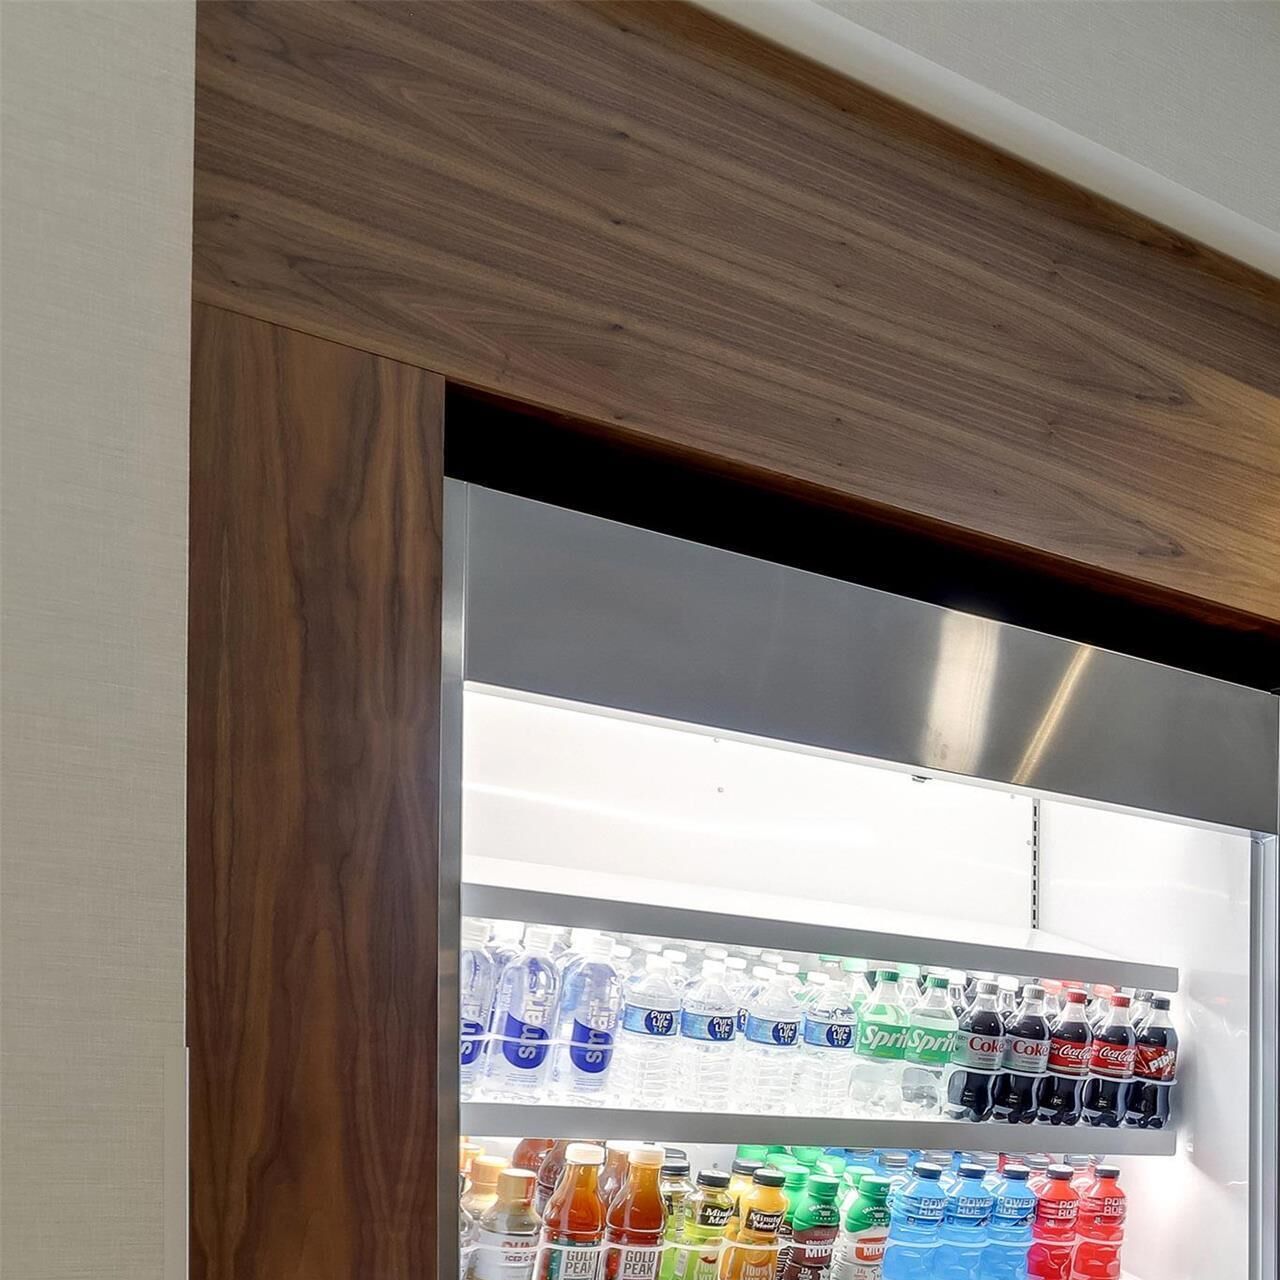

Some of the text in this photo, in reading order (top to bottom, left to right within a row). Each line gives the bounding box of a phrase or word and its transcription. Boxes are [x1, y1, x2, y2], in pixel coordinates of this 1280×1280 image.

[651, 1011, 671, 1021] Pure
[713, 1017, 731, 1026] Pure
[652, 1018, 668, 1029] Life
[716, 1024, 730, 1034] Life
[778, 1023, 795, 1031] Pure
[831, 1025, 849, 1033] Pure
[779, 1029, 793, 1040] Life
[833, 1031, 847, 1042] Life
[863, 1026, 908, 1049] Spri
[969, 1036, 1003, 1053] Coke
[1013, 1040, 1049, 1056] Coke
[1059, 1201, 1079, 1209] POW
[1104, 1197, 1126, 1207] POW
[625, 1250, 655, 1262] GOLD
[624, 1263, 654, 1275] PEAK
